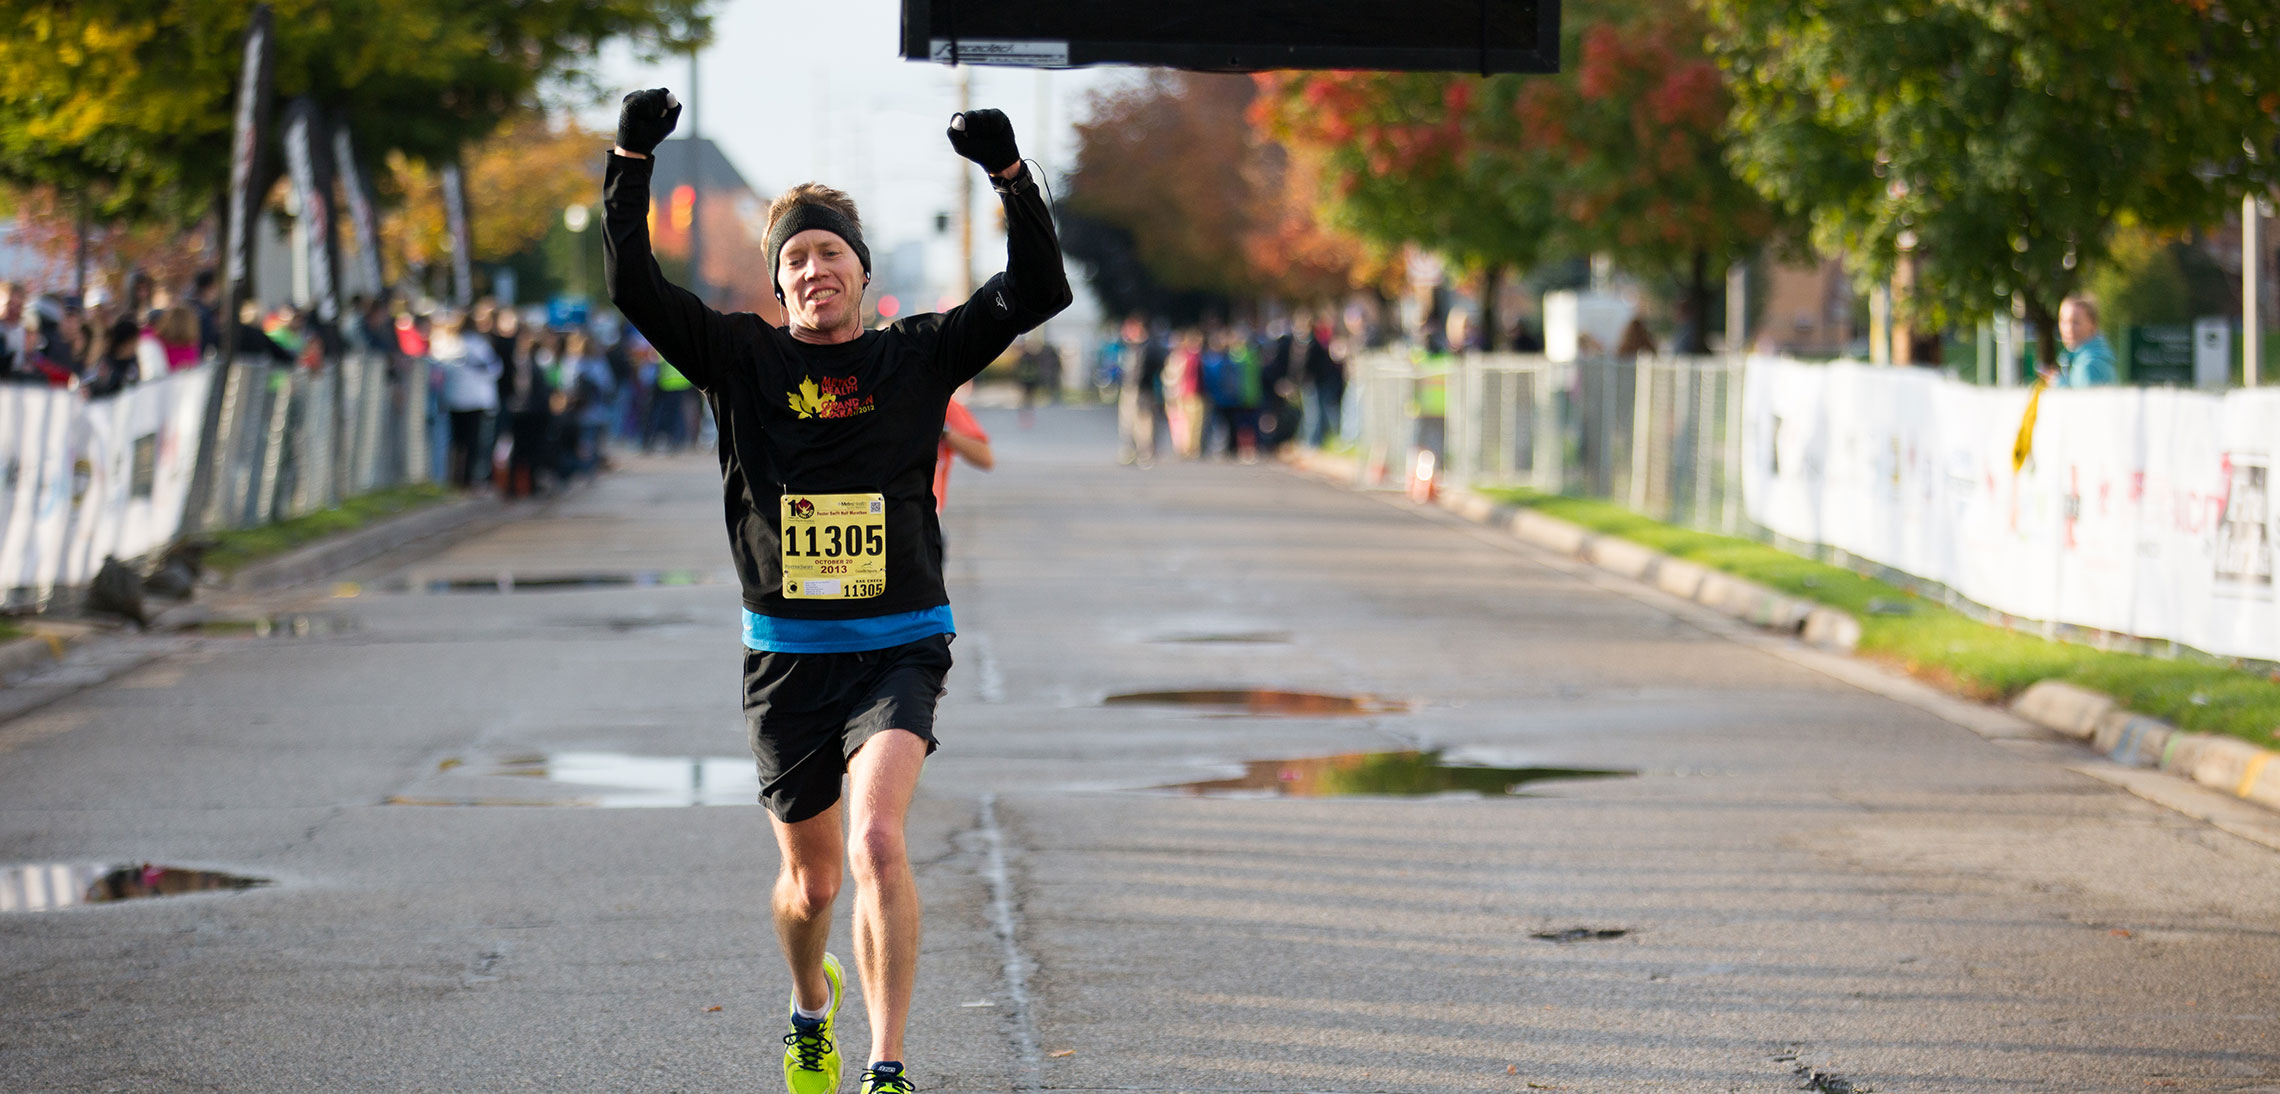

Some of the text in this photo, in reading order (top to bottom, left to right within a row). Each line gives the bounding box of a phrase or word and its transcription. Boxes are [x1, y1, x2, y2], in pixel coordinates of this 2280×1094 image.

[821, 384, 858, 396] HEALTH
[821, 398, 860, 411] GRAND
[785, 525, 882, 557] 11305
[820, 565, 848, 574] 2013
[844, 584, 882, 597] 11305
